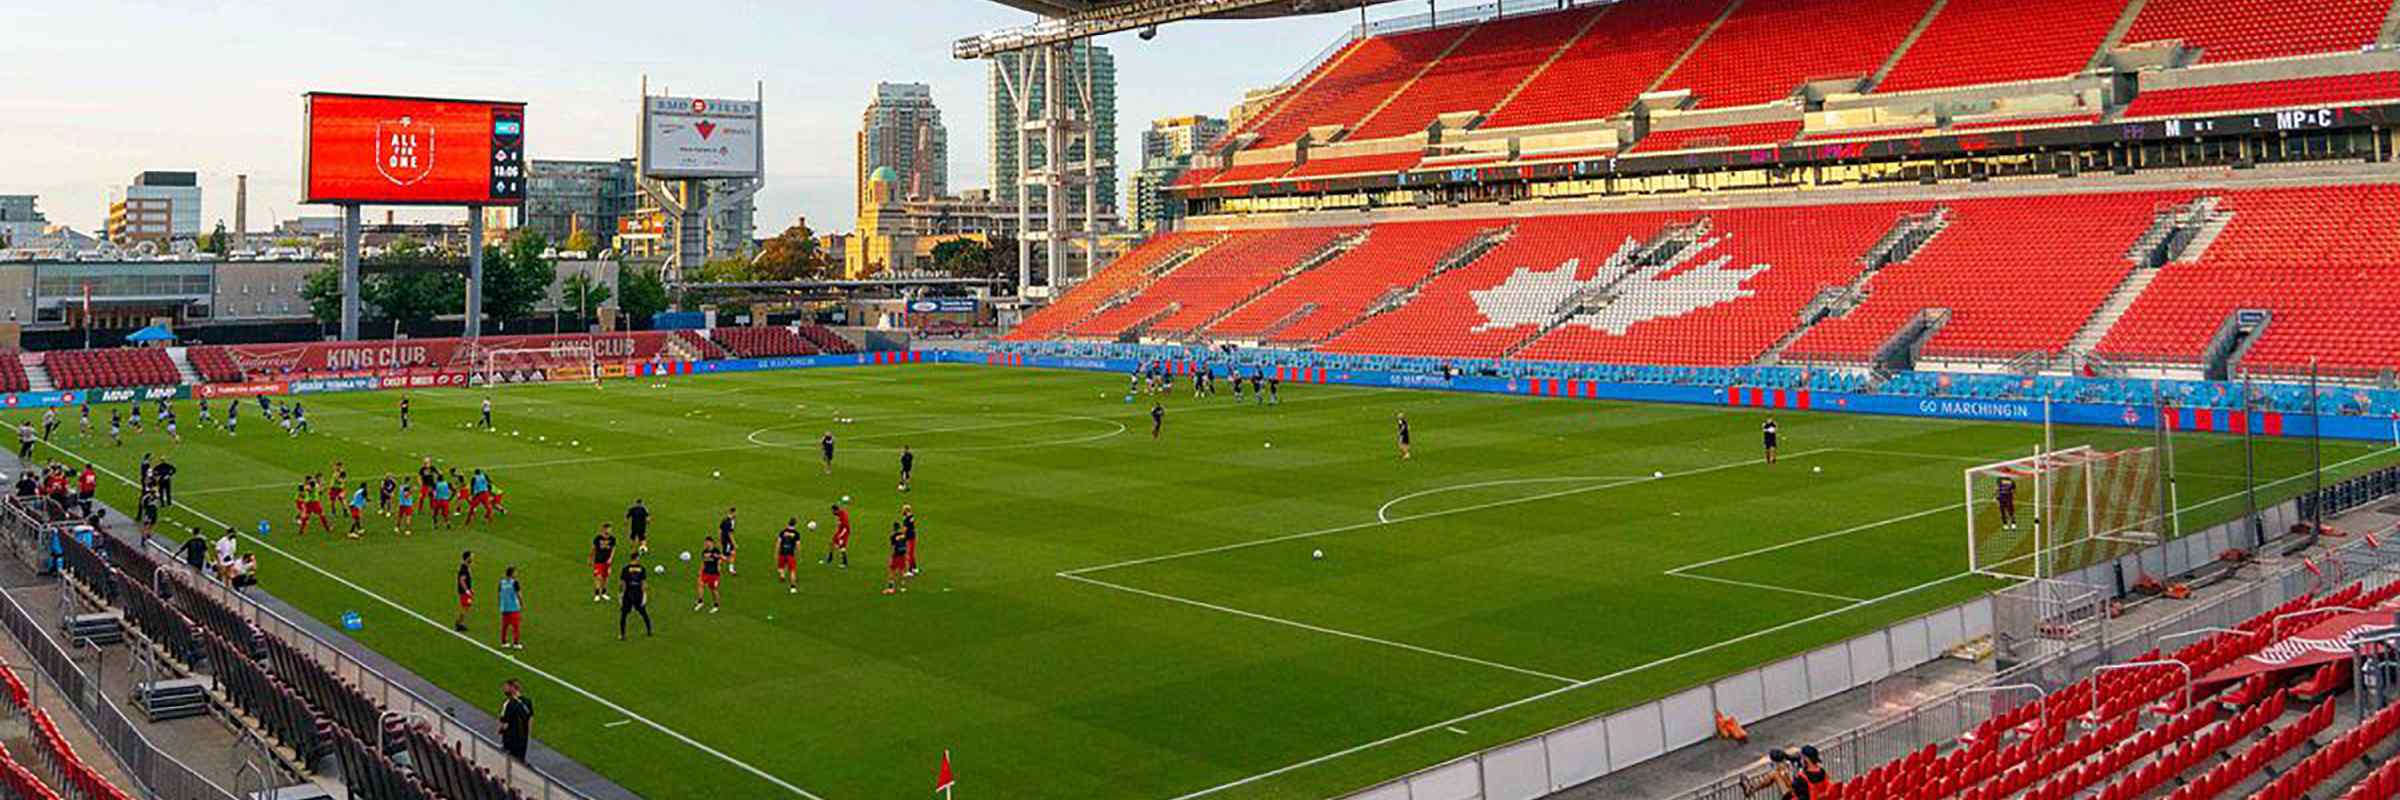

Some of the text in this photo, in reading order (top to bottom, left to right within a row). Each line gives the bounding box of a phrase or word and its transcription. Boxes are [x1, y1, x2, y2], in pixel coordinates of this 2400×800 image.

[657, 100, 688, 110] BMO
[391, 133, 417, 147] ALL
[389, 155, 417, 169] ONE
[551, 338, 590, 357] KING
[595, 338, 635, 356] CLUB
[326, 347, 373, 368] KING
[379, 346, 426, 367] CLUB
[102, 387, 177, 401] MNP MNP
[1919, 399, 1937, 413] GO
